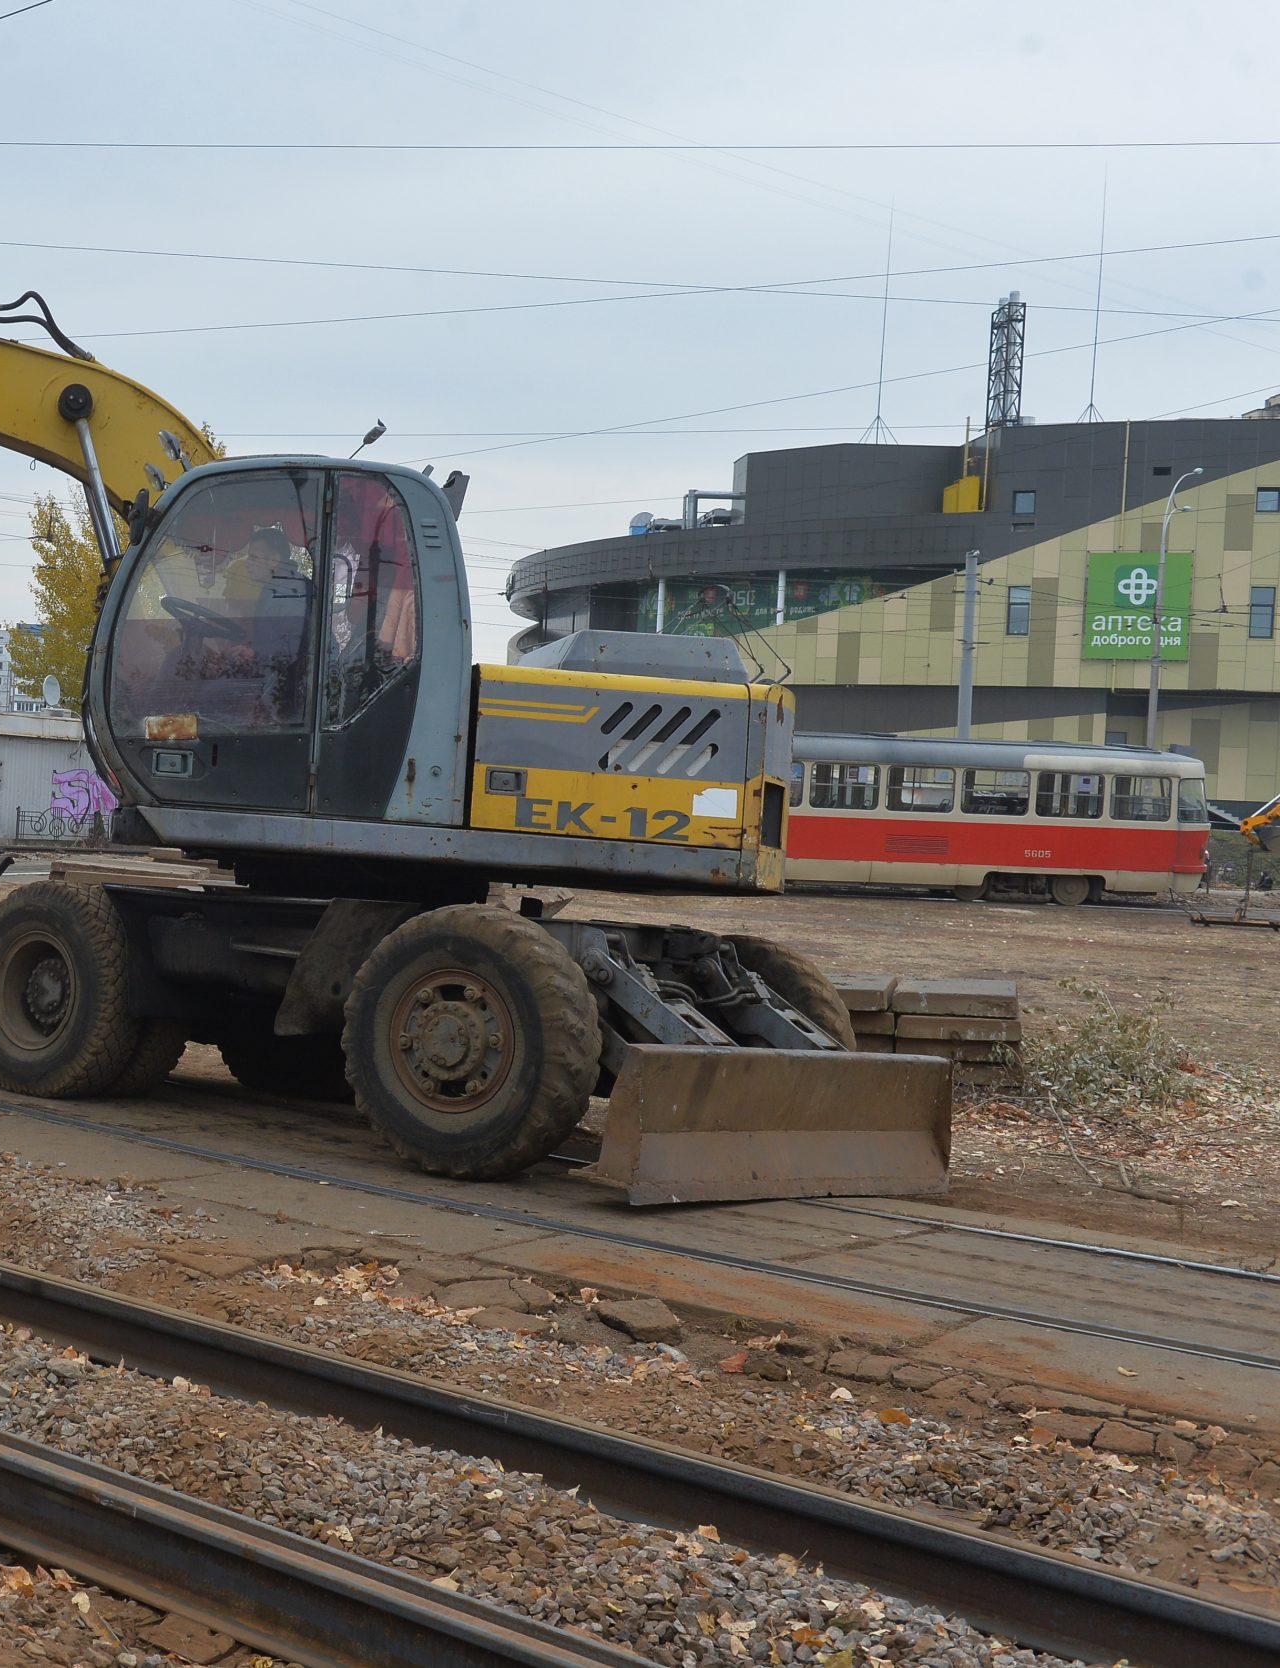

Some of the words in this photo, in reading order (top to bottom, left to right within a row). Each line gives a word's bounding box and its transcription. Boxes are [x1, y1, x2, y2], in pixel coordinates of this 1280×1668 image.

[1092, 615, 1182, 632] аптека
[1091, 633, 1151, 648] доброго
[515, 797, 691, 842] ЕК-12
[1024, 849, 1052, 858] 5605
